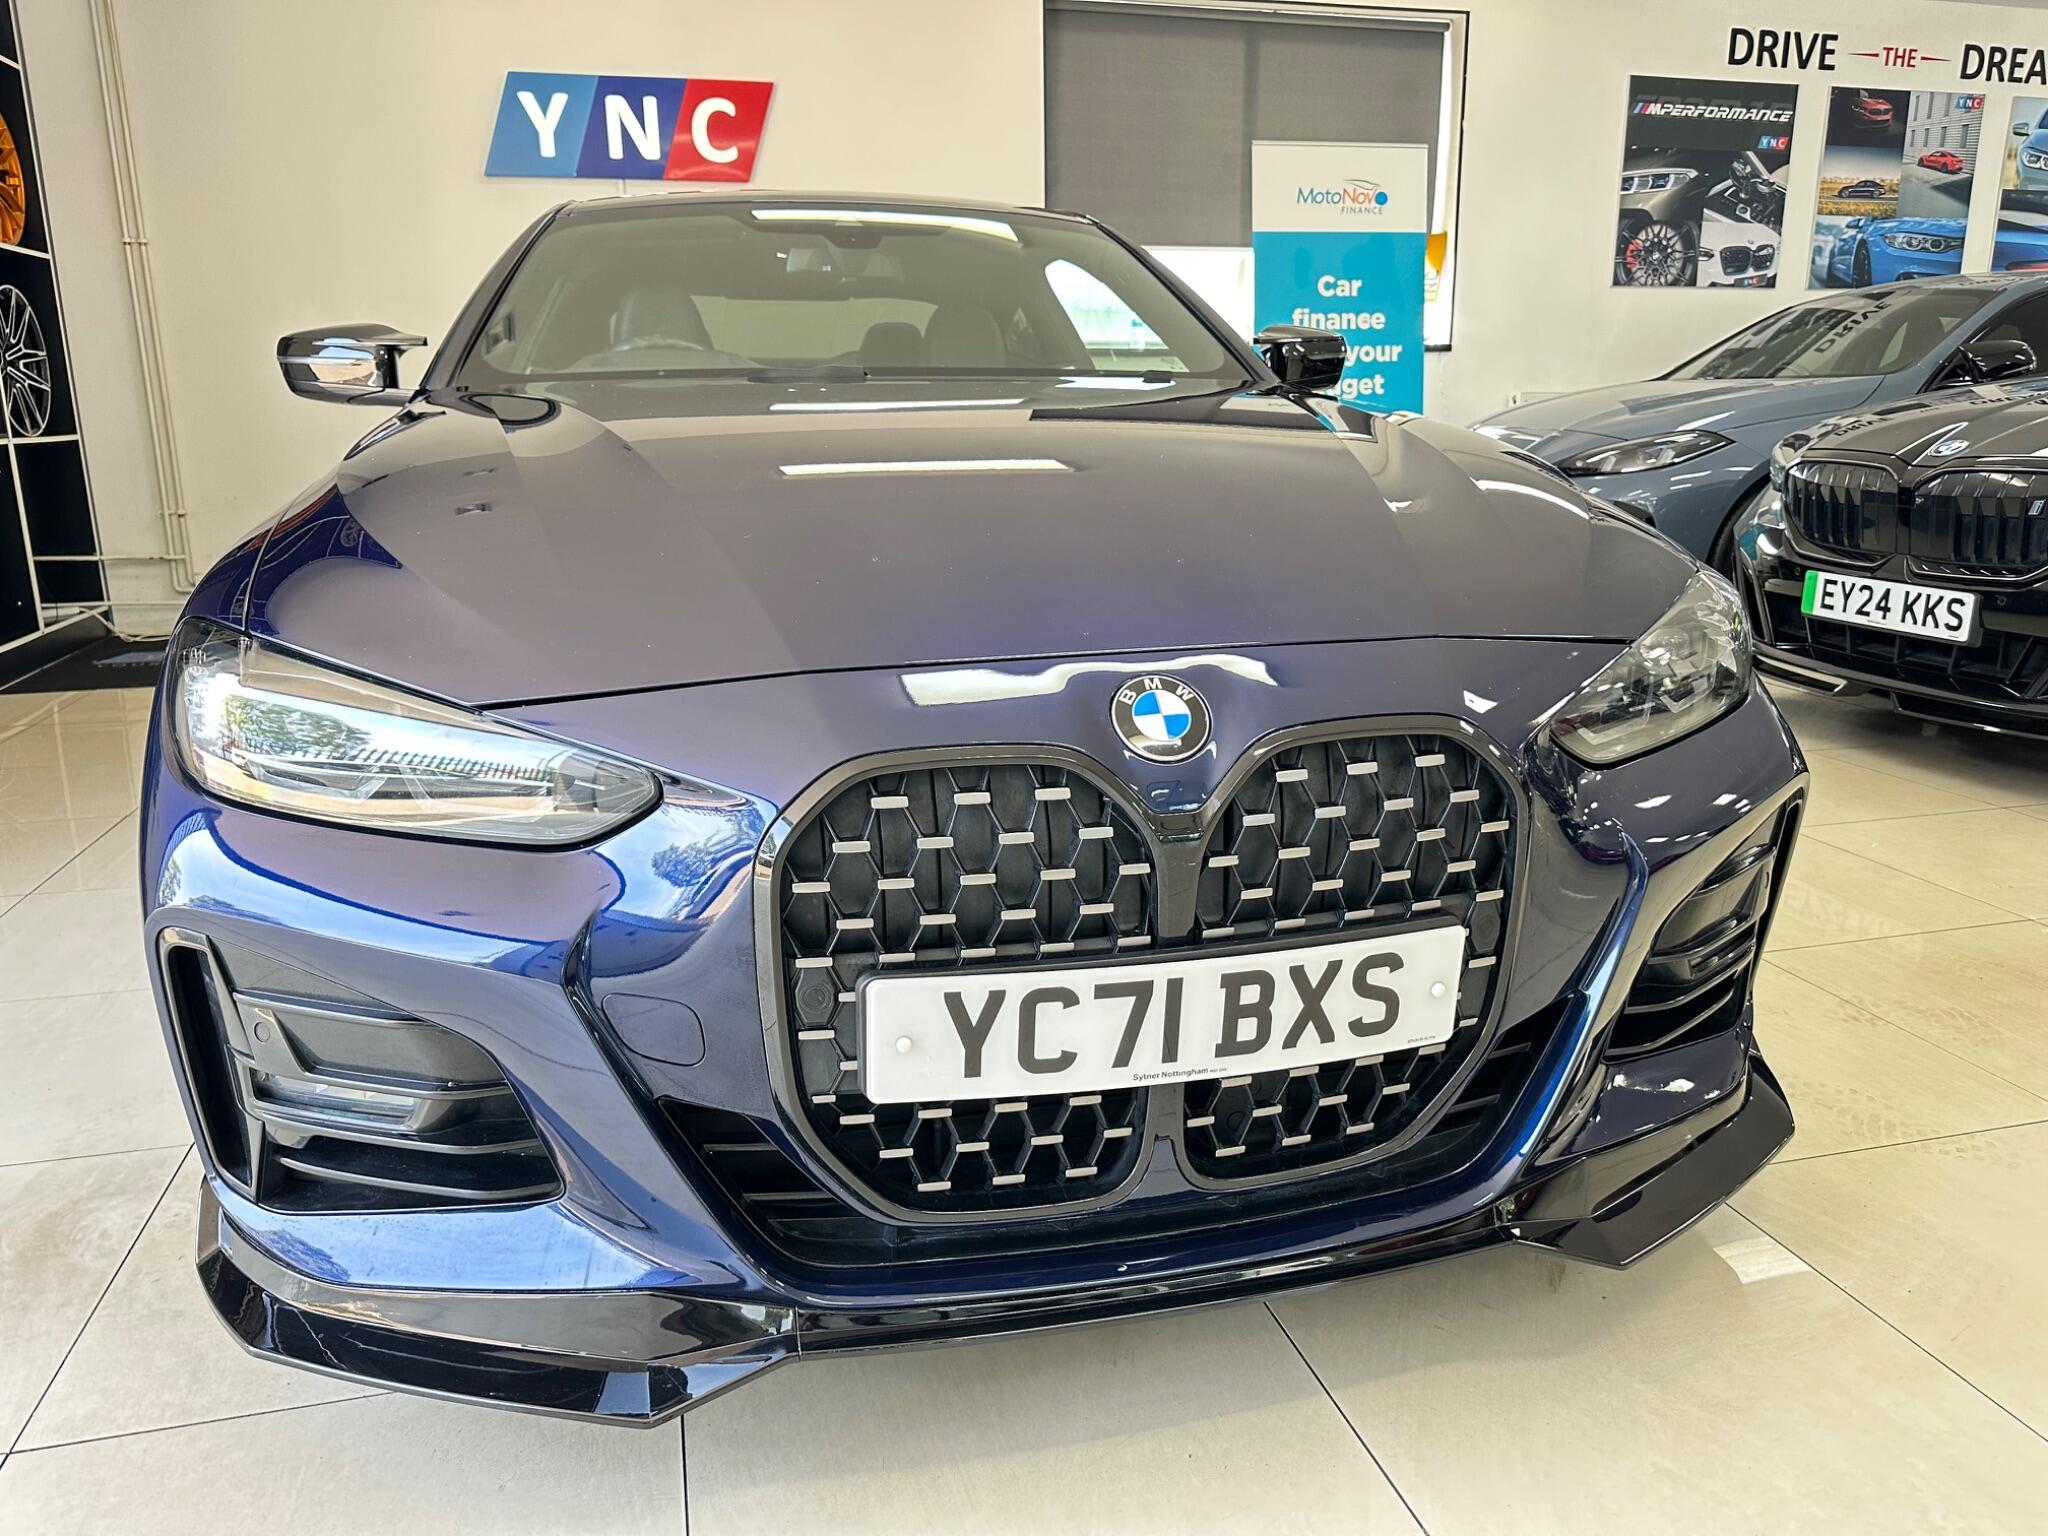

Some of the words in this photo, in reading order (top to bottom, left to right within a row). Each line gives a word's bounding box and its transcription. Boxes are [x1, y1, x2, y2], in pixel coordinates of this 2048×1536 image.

[1727, 27, 1839, 71] DRIVE
[1882, 46, 1918, 69] THE
[1960, 44, 2048, 85] DREA
[1959, 98, 1981, 108] YNC
[516, 90, 739, 164] YNC
[1760, 136, 1786, 148] YNC
[1297, 186, 1388, 206] MotoNovo
[1341, 206, 1383, 215] FINANCE
[1316, 275, 1362, 297] Car
[1291, 308, 1386, 331] finance
[1345, 344, 1402, 367] your
[1820, 579, 1891, 620] EY24
[1900, 590, 1966, 632] KKS
[1118, 677, 1195, 705] BMW
[942, 977, 1184, 1079] YC71
[1214, 951, 1406, 1058] BXS
[1133, 1073, 1160, 1082] Sytner
[1161, 1068, 1208, 1078] Nottingham
